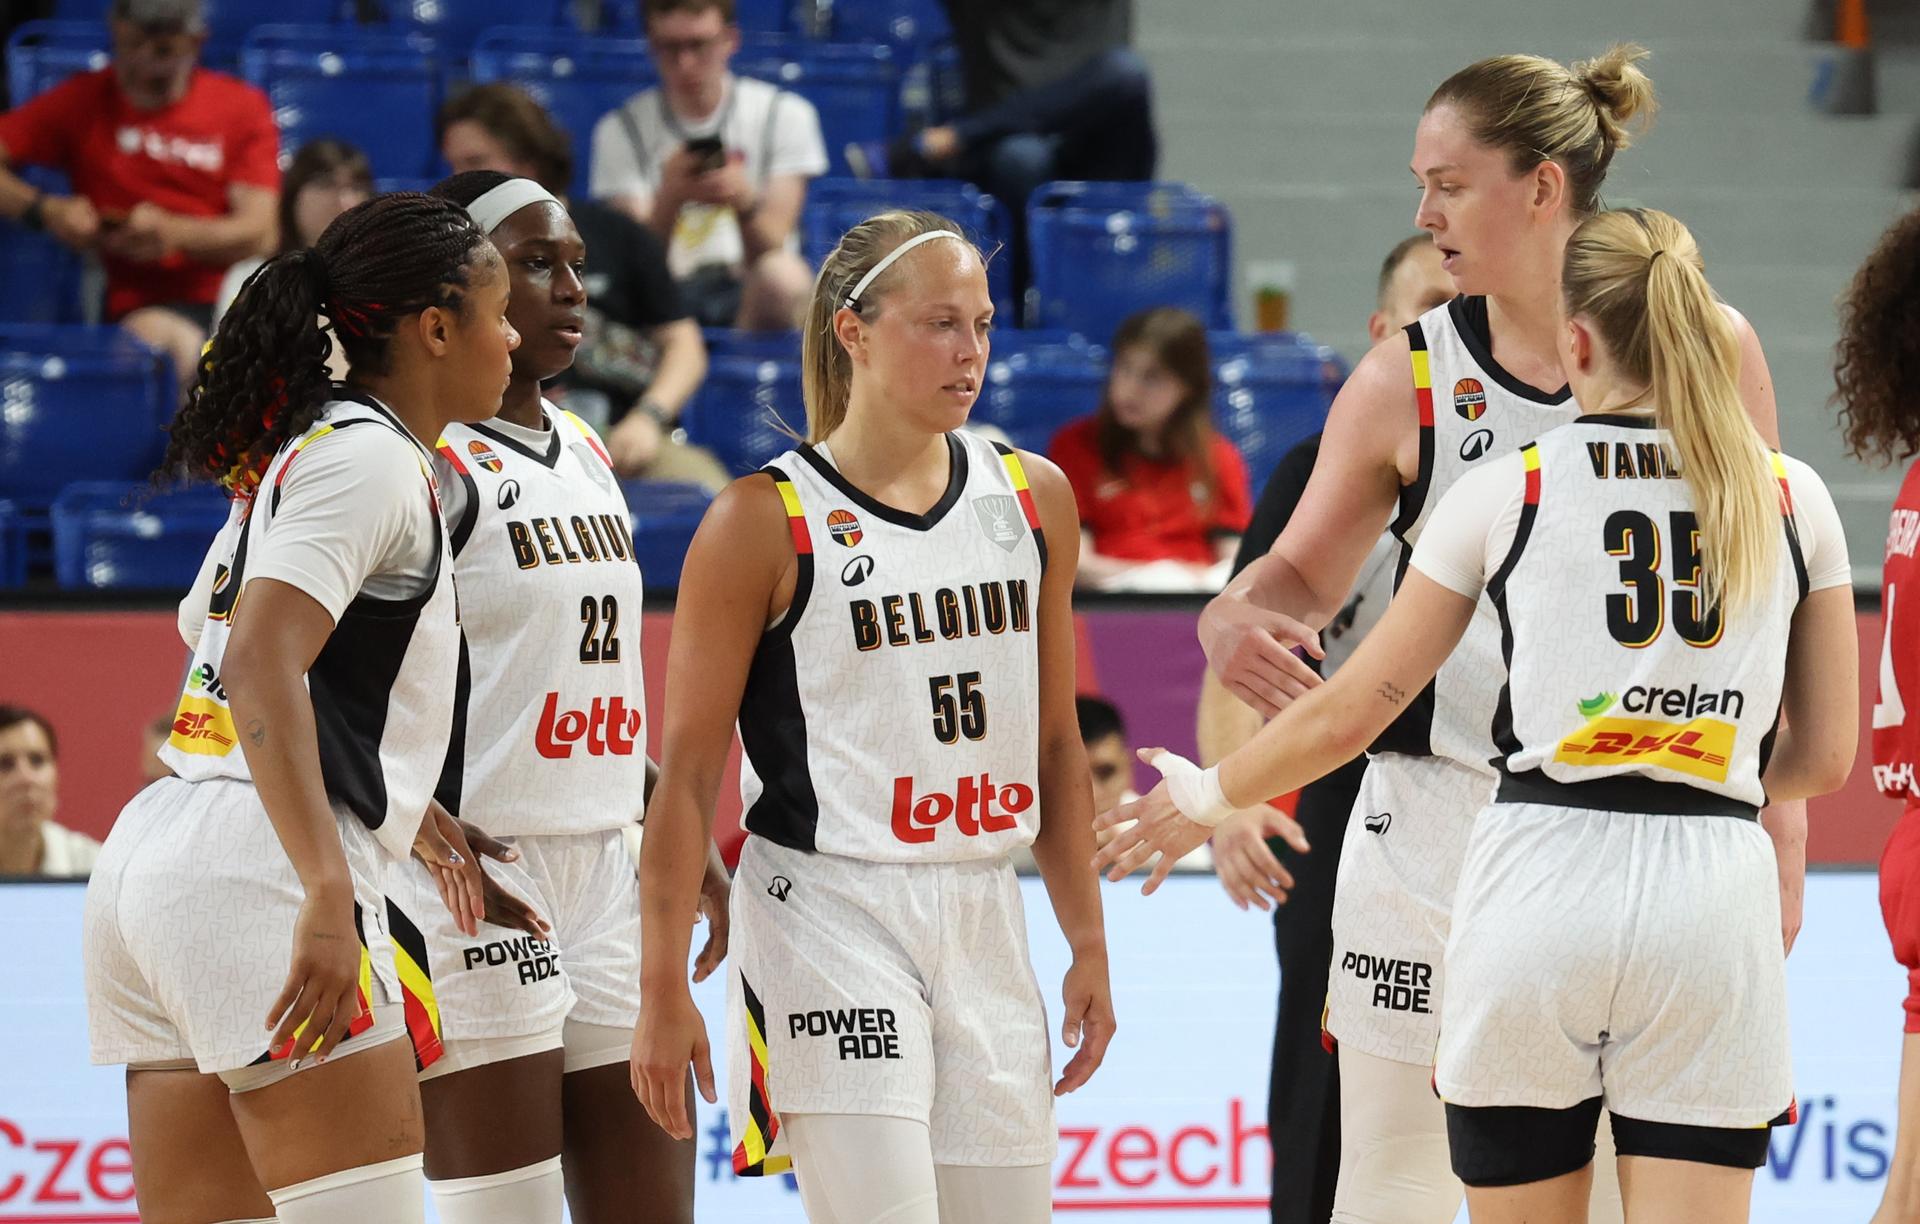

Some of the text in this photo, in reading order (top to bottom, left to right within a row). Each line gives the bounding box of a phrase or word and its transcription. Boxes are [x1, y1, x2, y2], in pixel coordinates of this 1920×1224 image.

[1603, 510, 1726, 648] 35
[580, 595, 621, 664] 22
[850, 579, 1030, 652] BELGIUM
[535, 691, 641, 759] Lotto
[929, 671, 988, 745] 55
[1622, 683, 1744, 719] crelan
[1585, 731, 1704, 760] DHL
[891, 773, 1034, 844] Lotto
[1342, 951, 1432, 988] POWER
[788, 1009, 897, 1039] POWER
[1056, 1098, 1273, 1189] zech
[1768, 1095, 1890, 1181] Vis
